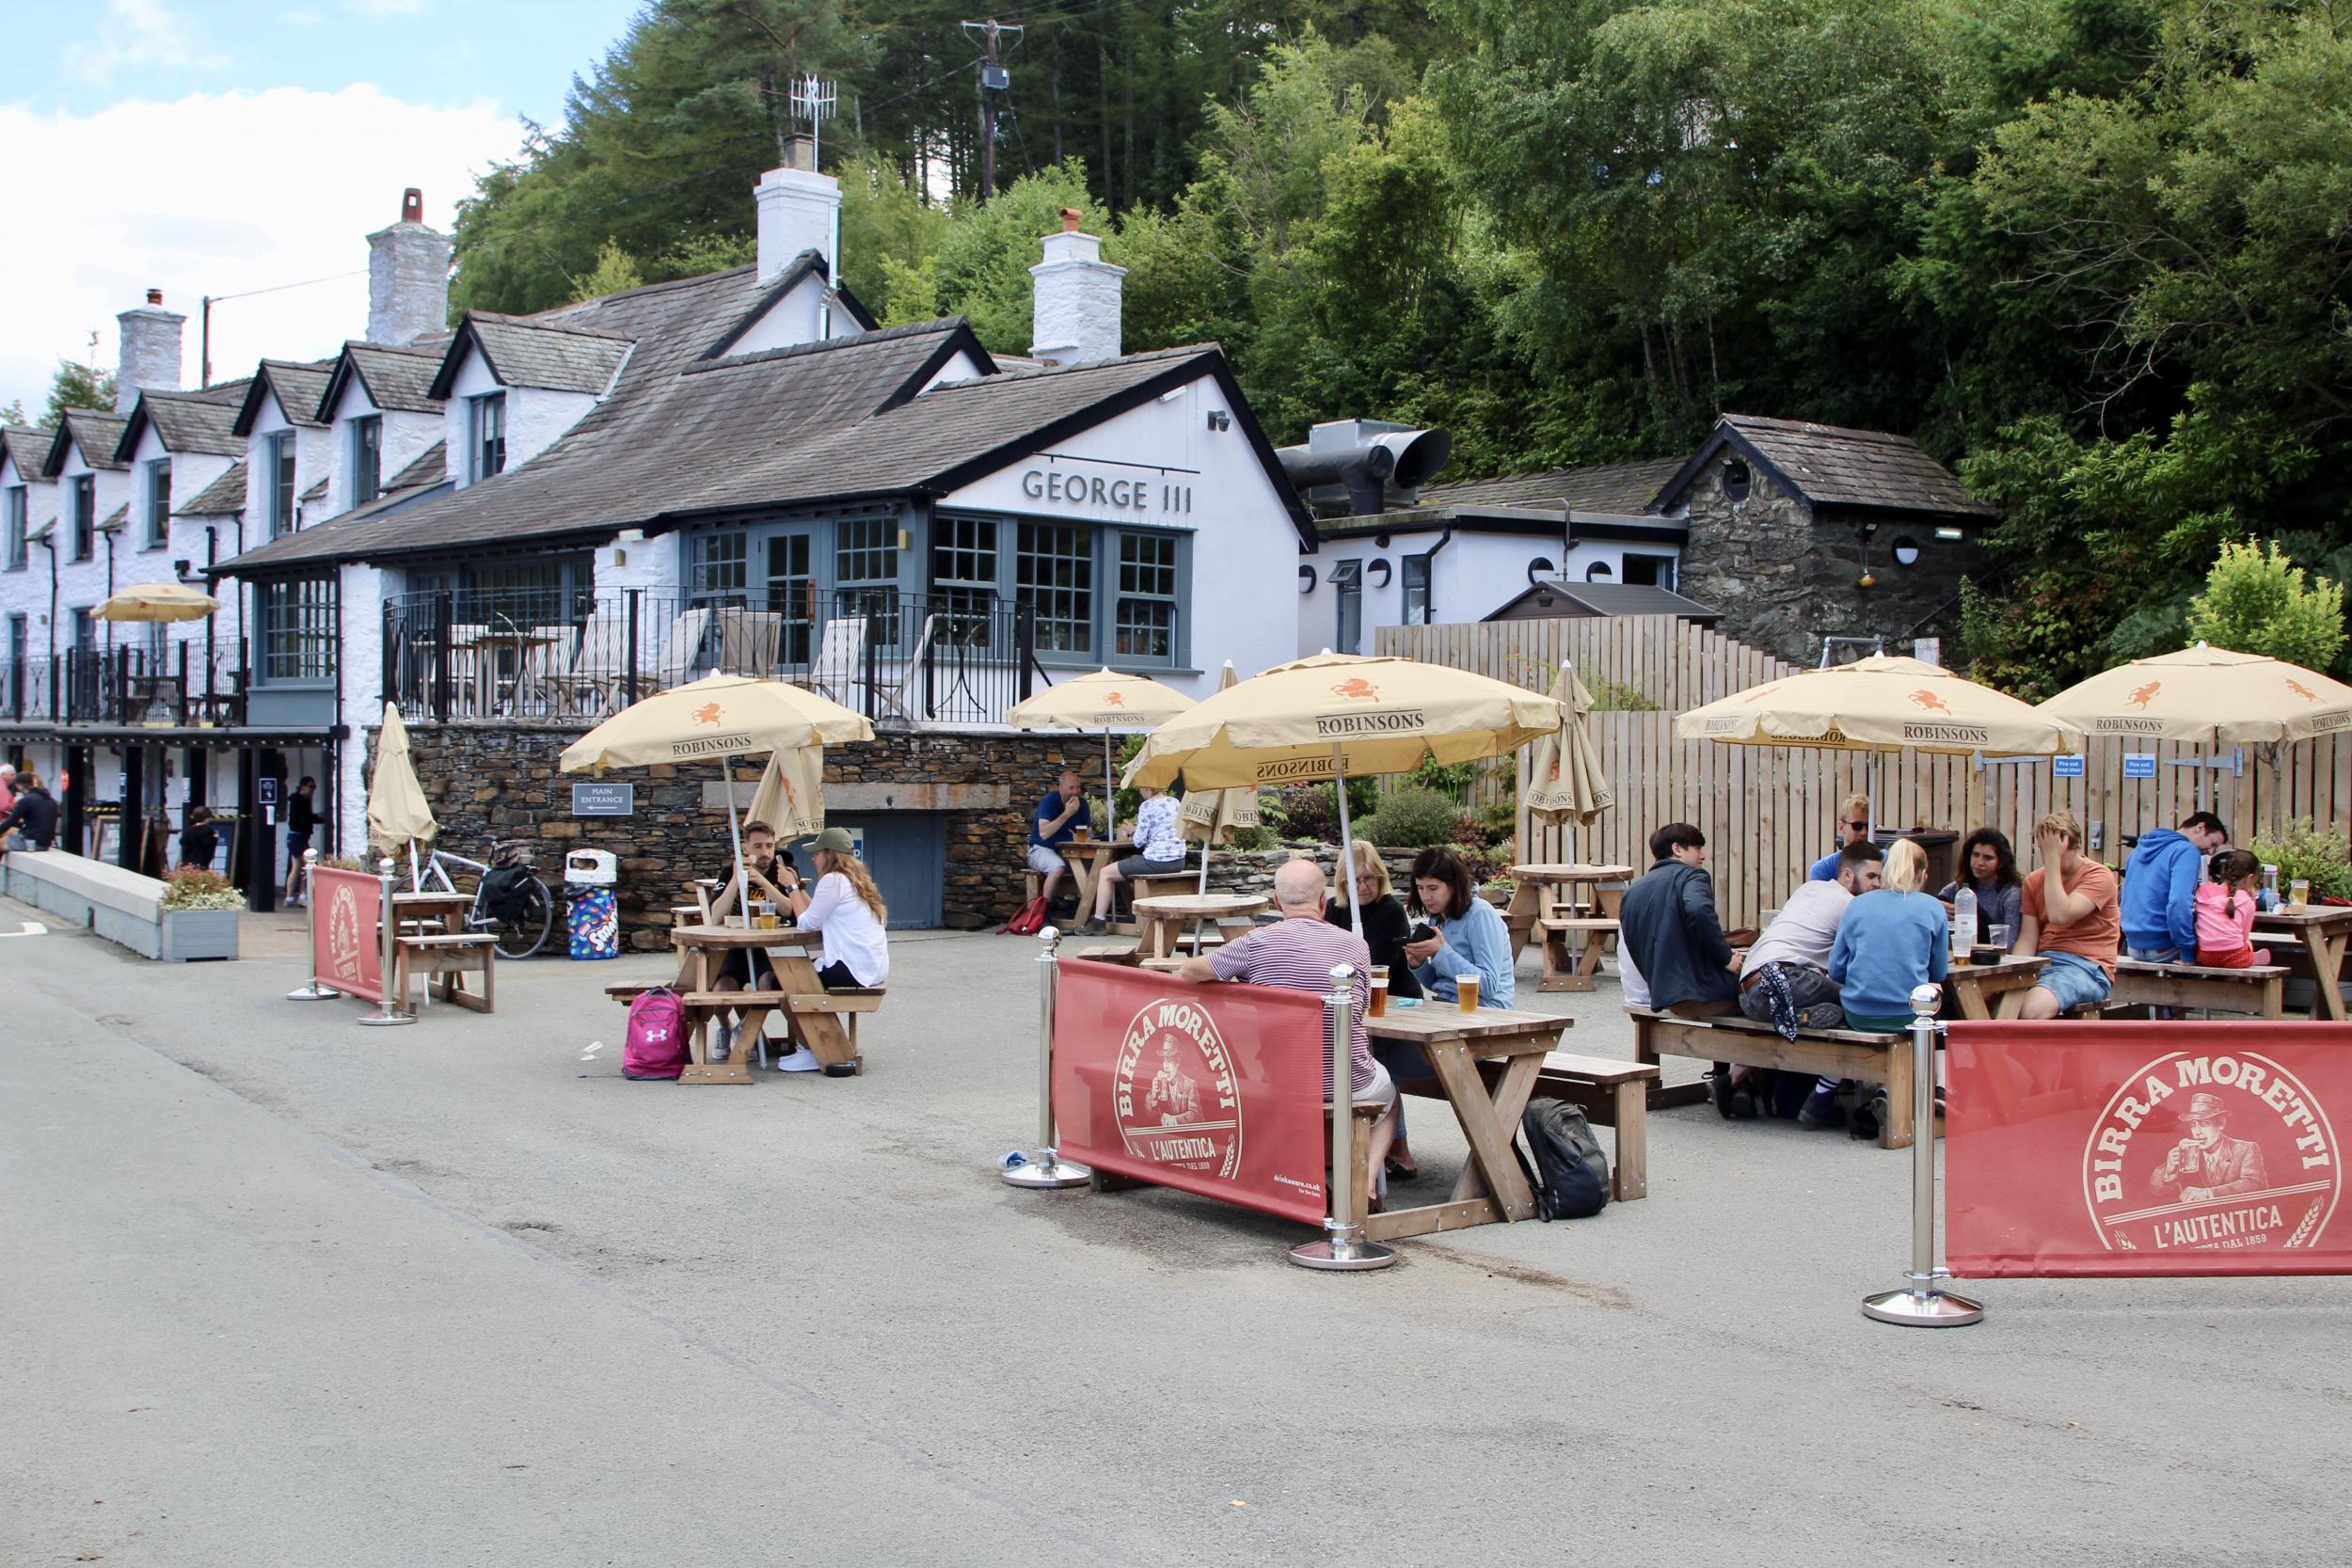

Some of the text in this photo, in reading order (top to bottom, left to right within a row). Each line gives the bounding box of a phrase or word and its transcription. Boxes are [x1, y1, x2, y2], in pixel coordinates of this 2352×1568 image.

[1022, 470, 1191, 513] GEORGE III
[1093, 715, 1145, 724] ROBINSONS
[1317, 713, 1424, 734] ROBINSONS
[2096, 719, 2163, 732] ROBINSONS
[1903, 725, 1988, 742] ROBINSONS
[672, 736, 752, 755] ROBINSONS
[1119, 1004, 1235, 1117] BIRRA MORETTI
[2094, 1055, 2331, 1203] BIRRA MORETTI
[1150, 1137, 1216, 1161] L'AUTENTICA
[1273, 1174, 1321, 1191] drinkaware.co.uk
[2153, 1205, 2283, 1249] L'AUTENTICA
[2222, 1238, 2243, 1249] DAL
[2245, 1233, 2267, 1245] 1859
